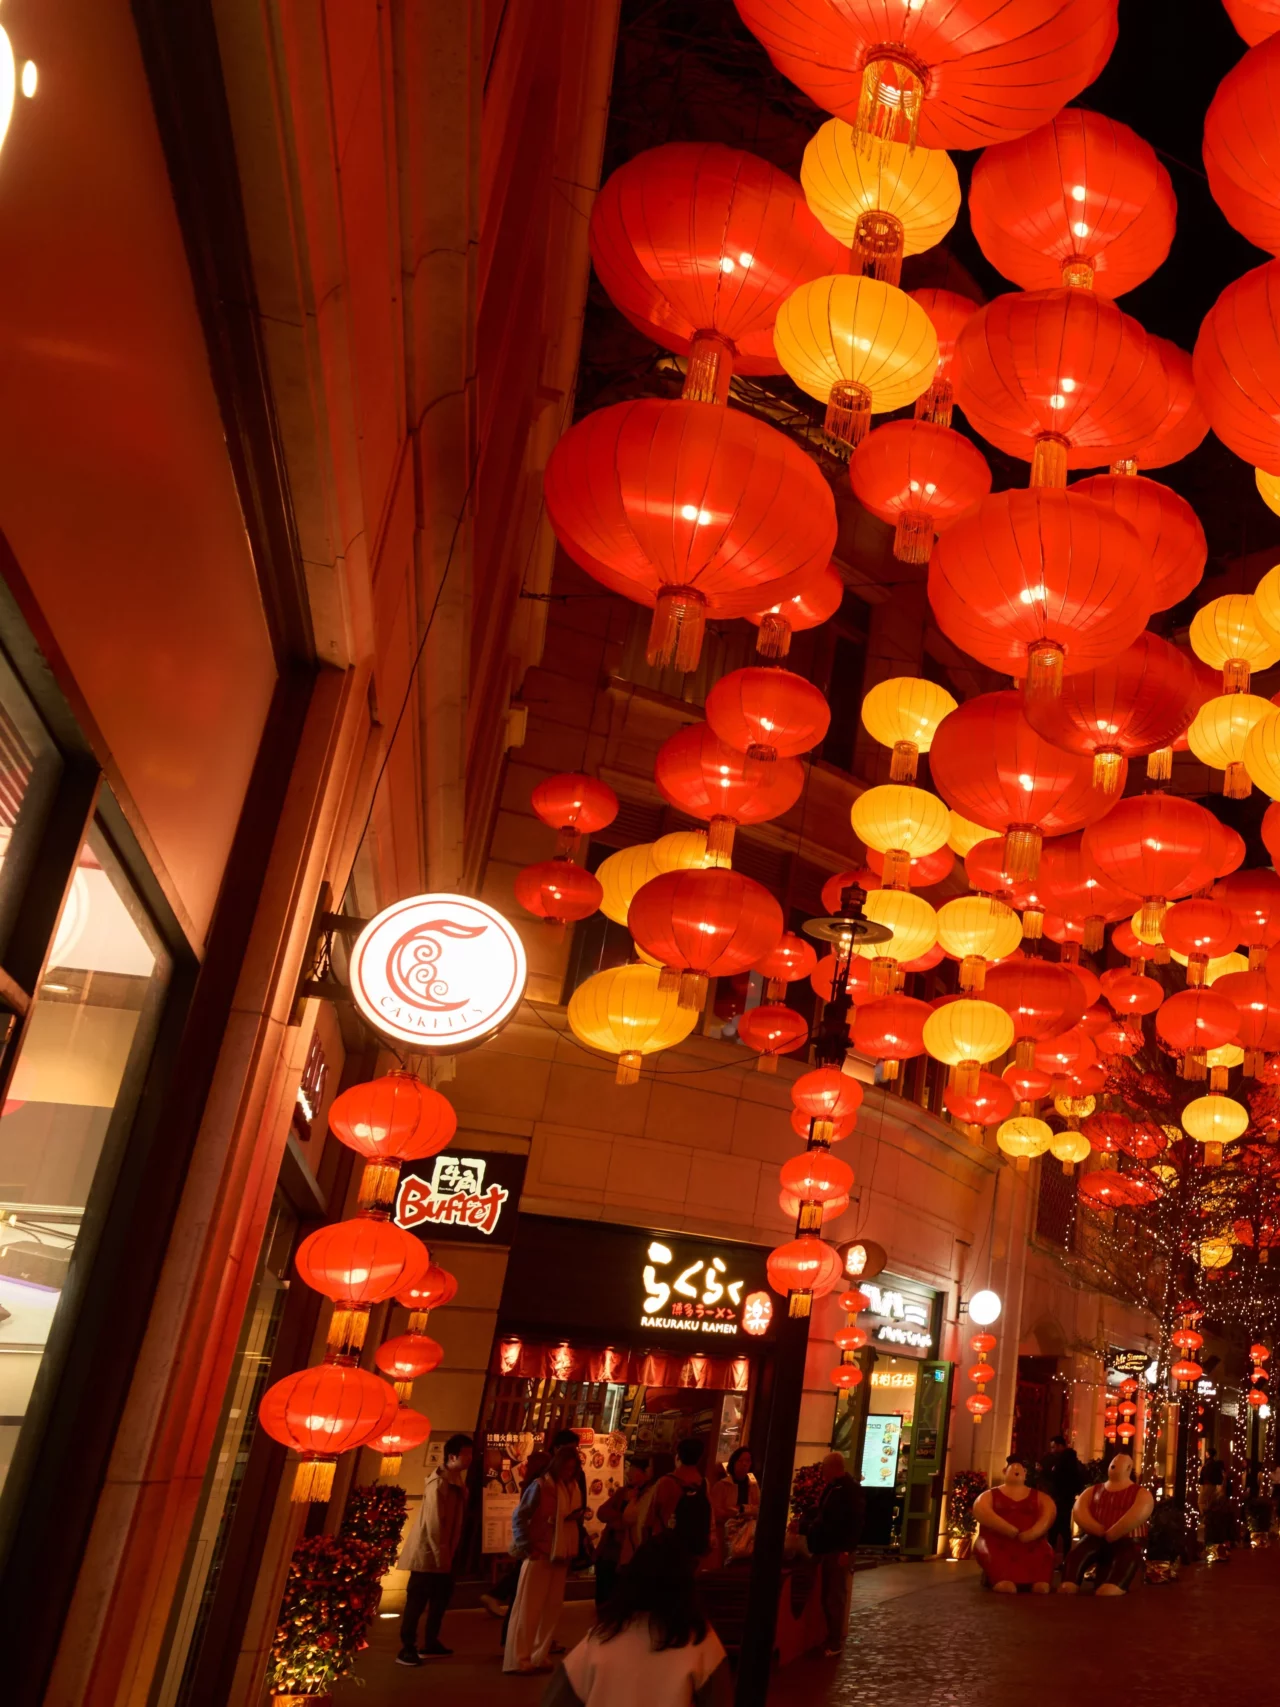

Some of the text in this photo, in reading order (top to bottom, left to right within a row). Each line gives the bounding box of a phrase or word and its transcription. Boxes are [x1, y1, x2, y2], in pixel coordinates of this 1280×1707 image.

[380, 996, 483, 1029] CASKS
[439, 1164, 477, 1194] 牛角
[394, 1174, 509, 1235] Buffet
[643, 1241, 744, 1314] らくらく
[640, 1316, 738, 1335] RAKURAKU RAMEN
[671, 1302, 736, 1320] 博多ラーメン
